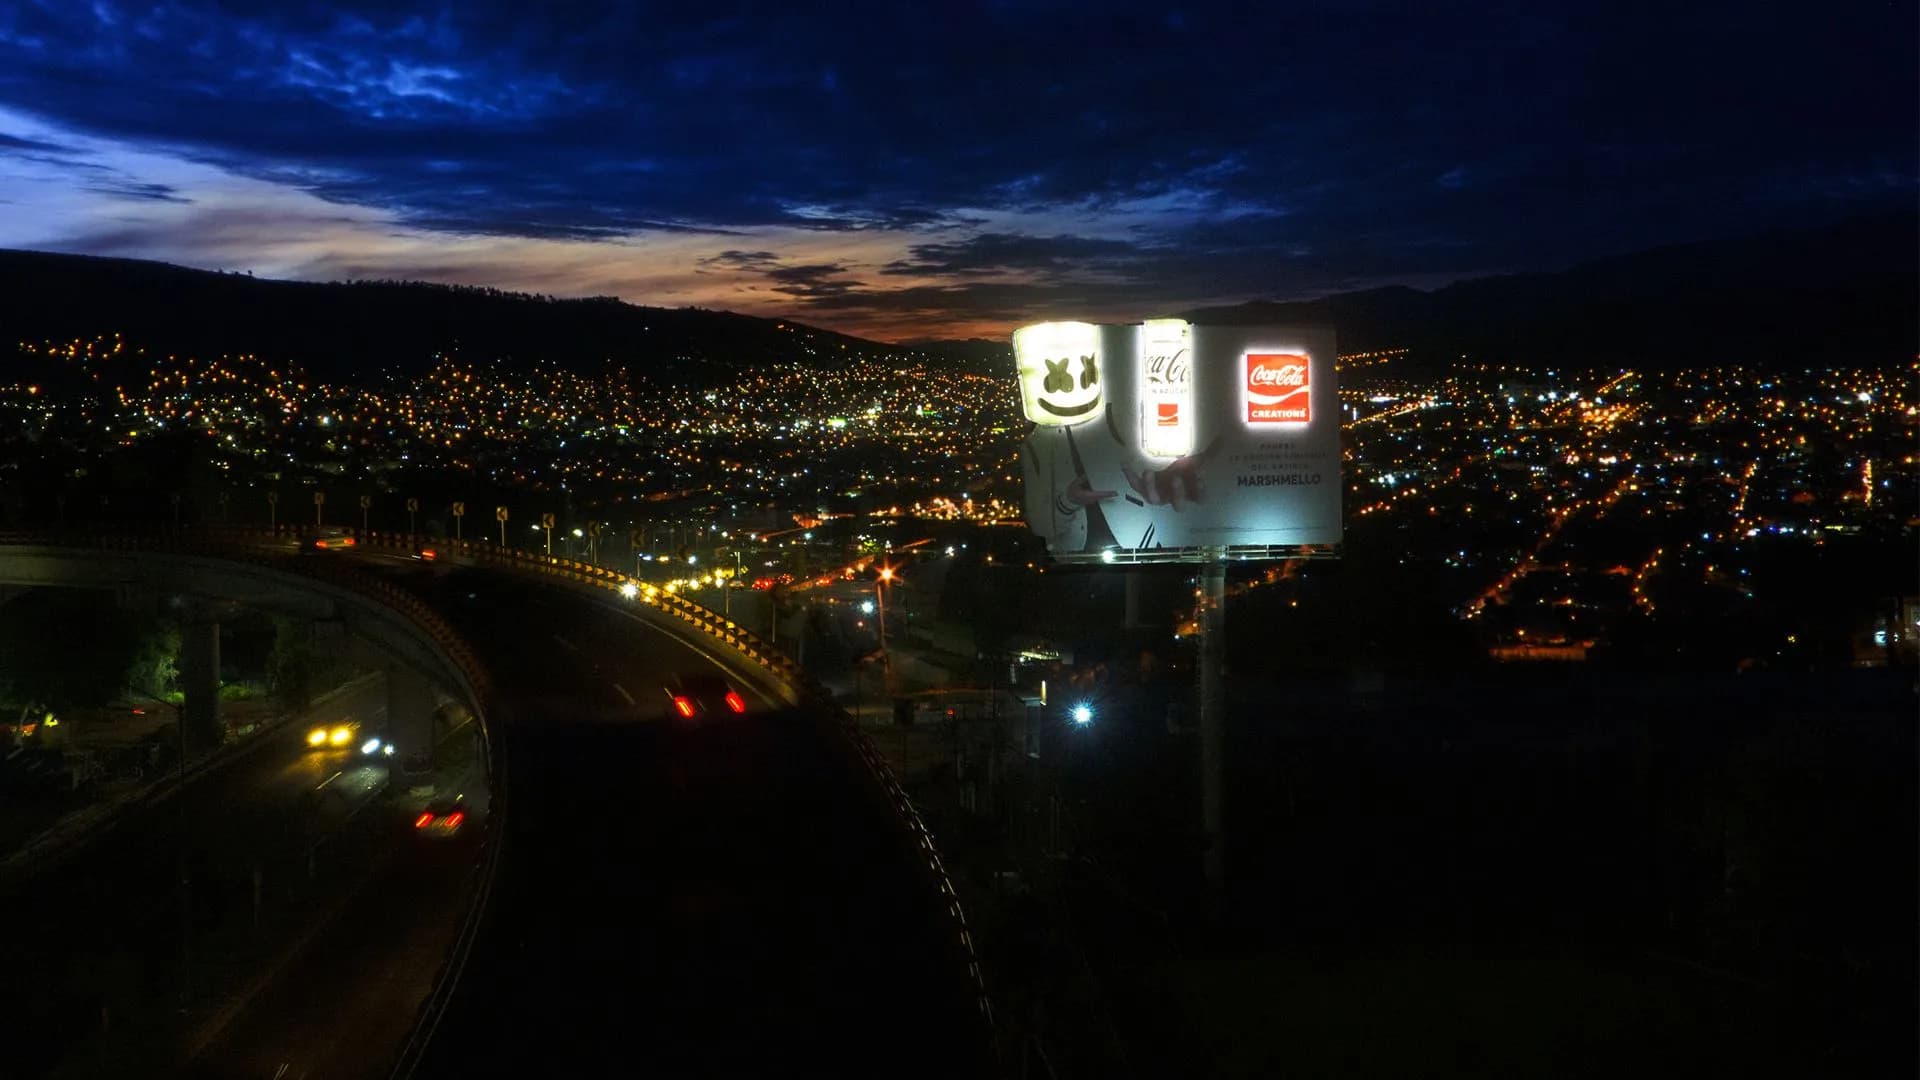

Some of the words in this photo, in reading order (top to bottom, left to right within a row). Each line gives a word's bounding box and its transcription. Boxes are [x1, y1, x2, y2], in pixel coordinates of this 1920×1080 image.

[1250, 364, 1306, 386] Coca-Cola
[1251, 408, 1306, 418] CREATIONS
[1237, 473, 1321, 487] MARSHMELLO
